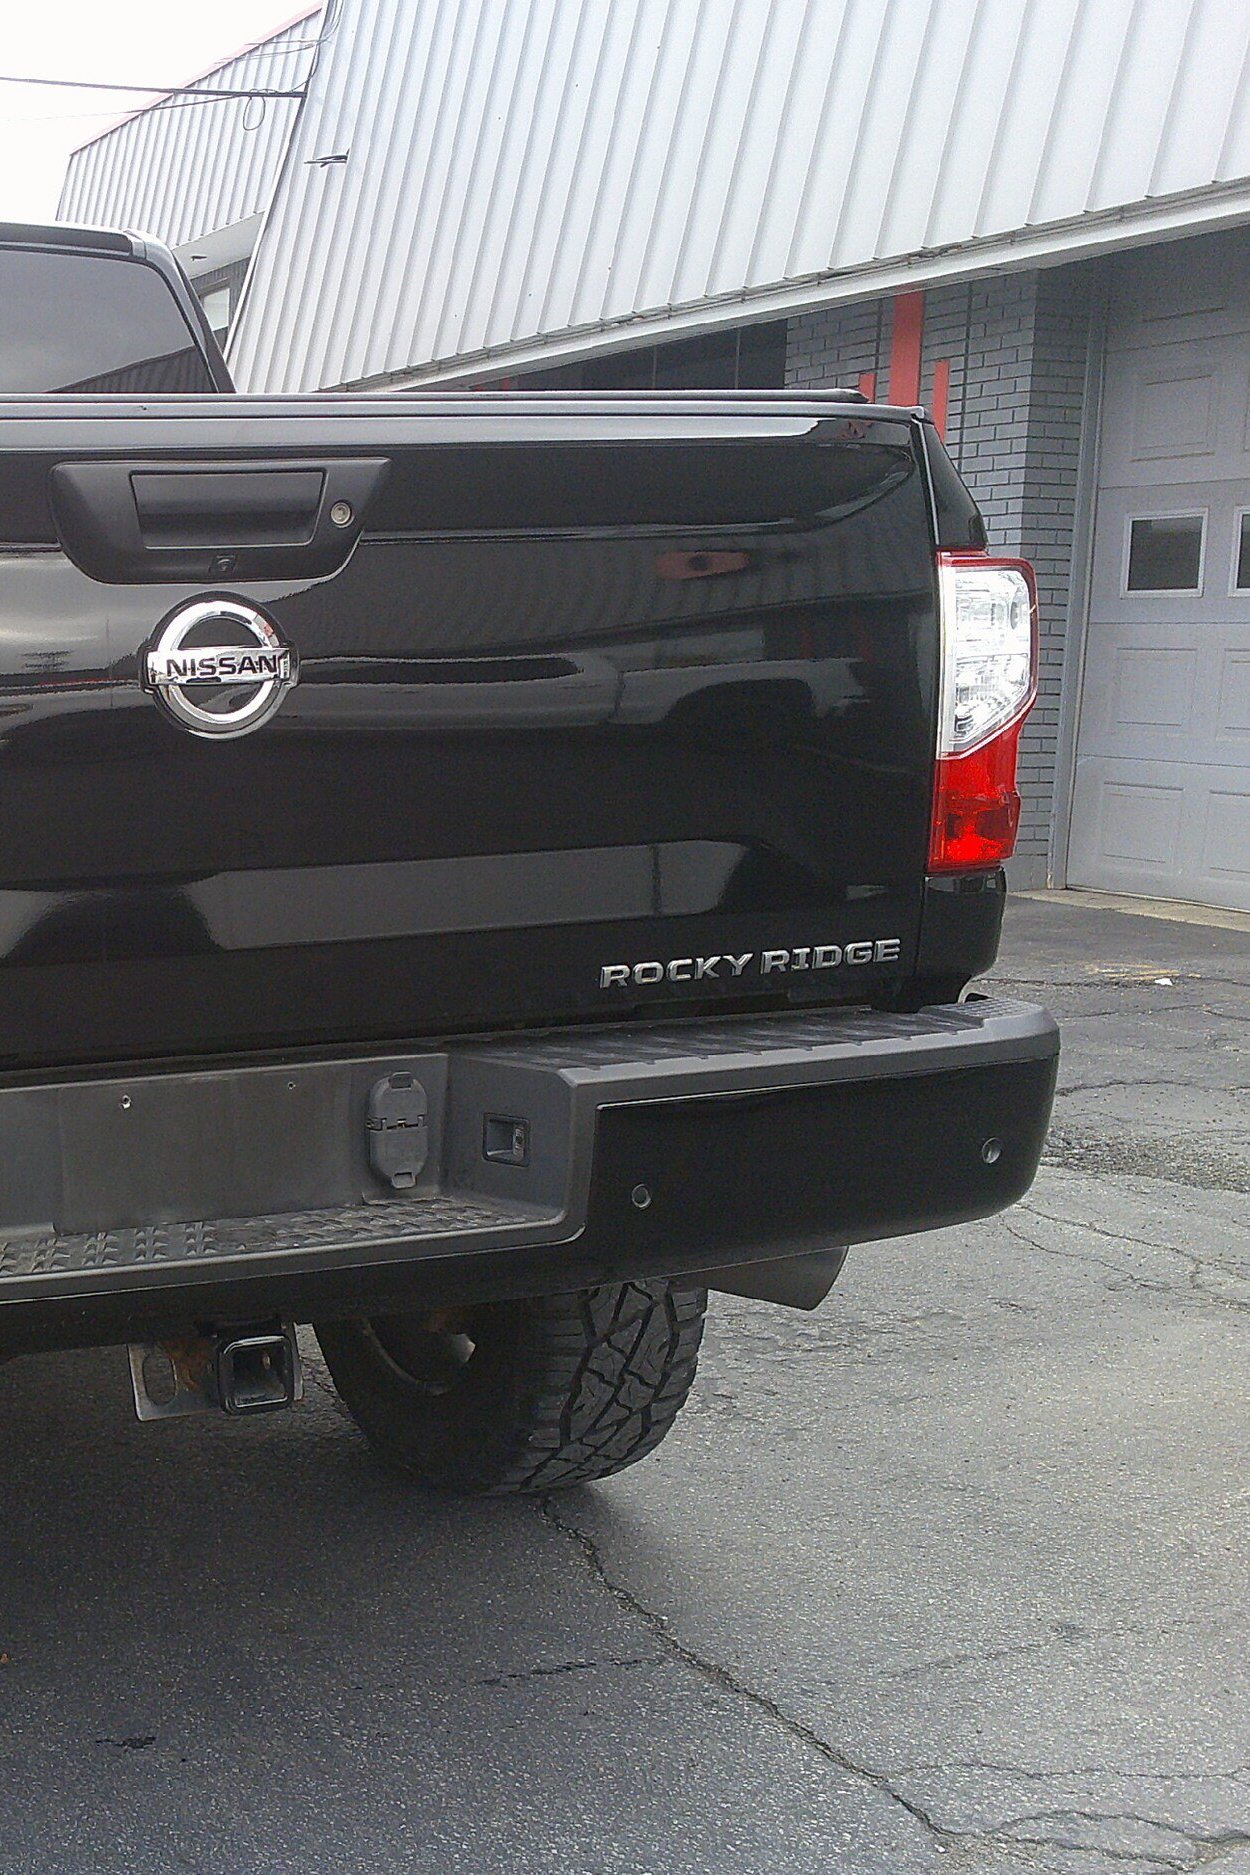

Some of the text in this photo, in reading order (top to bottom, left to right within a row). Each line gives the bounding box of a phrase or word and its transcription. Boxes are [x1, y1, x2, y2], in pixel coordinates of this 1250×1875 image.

[166, 654, 279, 677] NISSAN
[599, 938, 901, 988] ROCKY RIDGE
